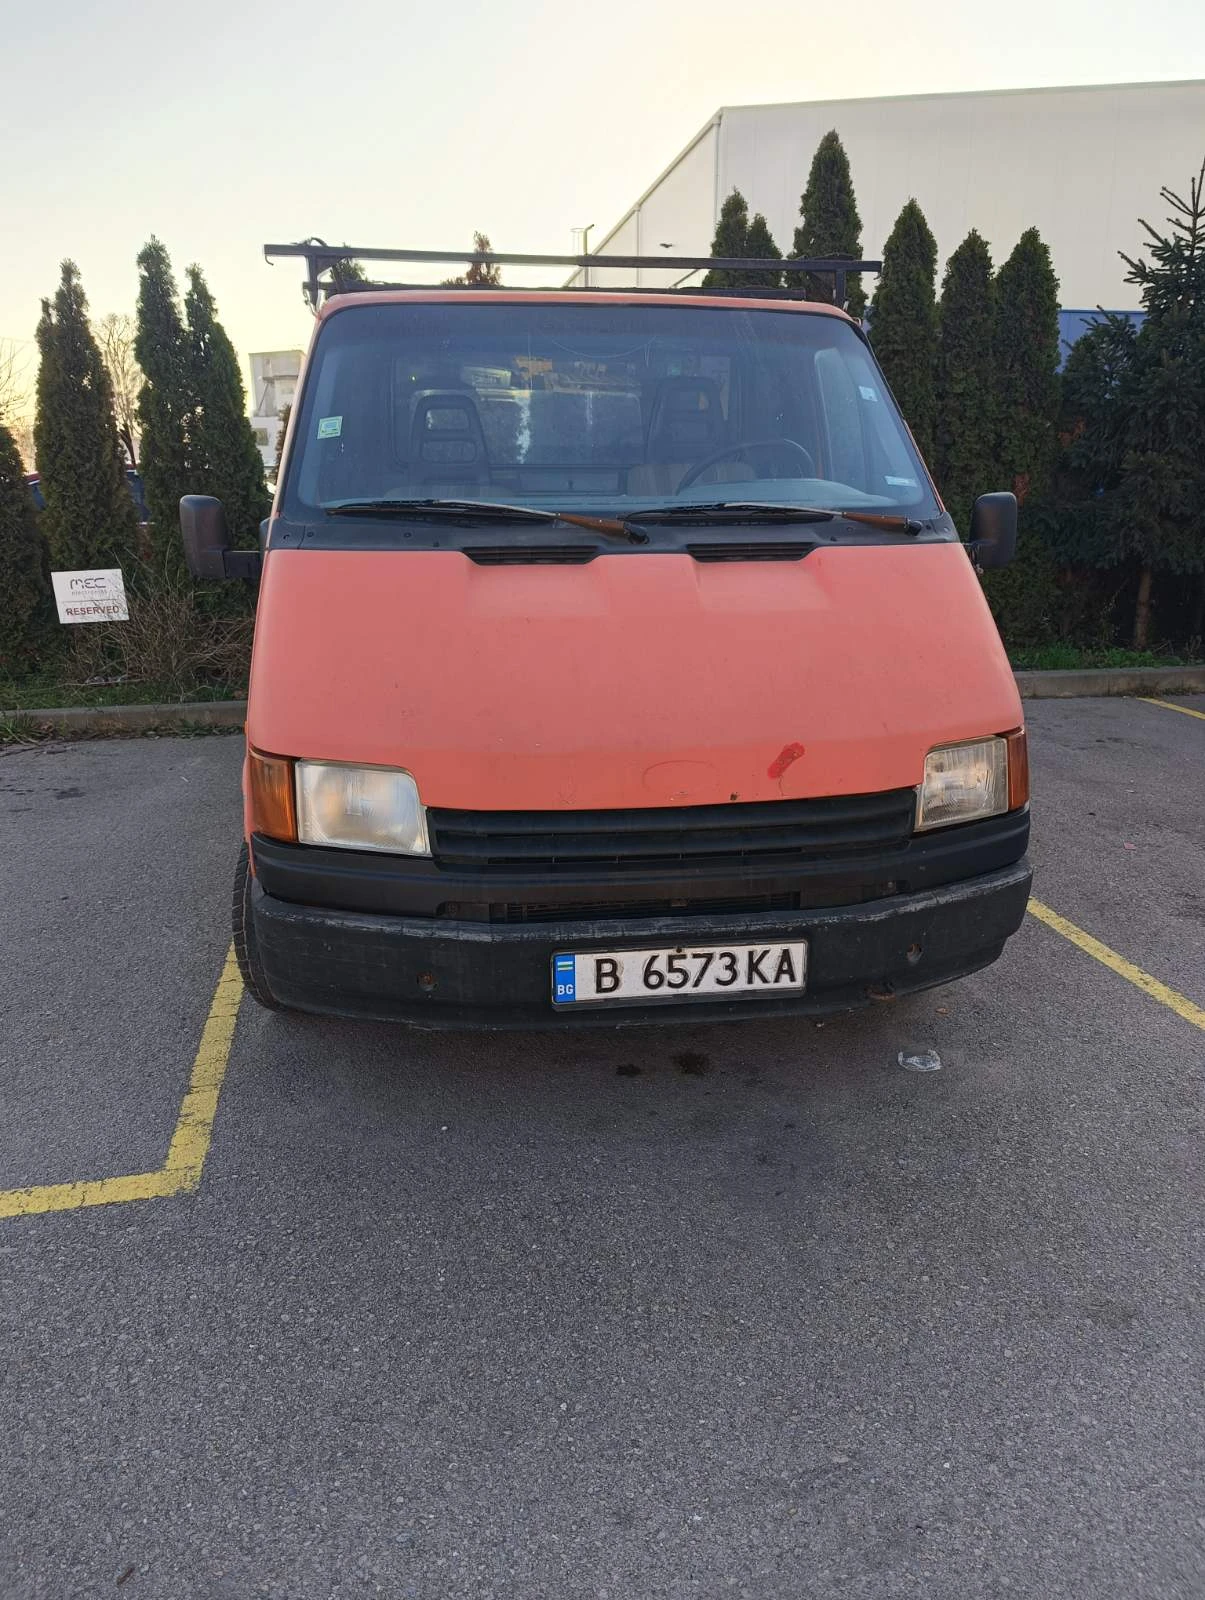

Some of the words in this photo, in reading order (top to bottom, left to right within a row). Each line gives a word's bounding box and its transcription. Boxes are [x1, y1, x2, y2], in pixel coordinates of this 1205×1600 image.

[66, 605, 119, 616] RESERVED
[595, 958, 620, 994] B
[557, 984, 574, 996] BG
